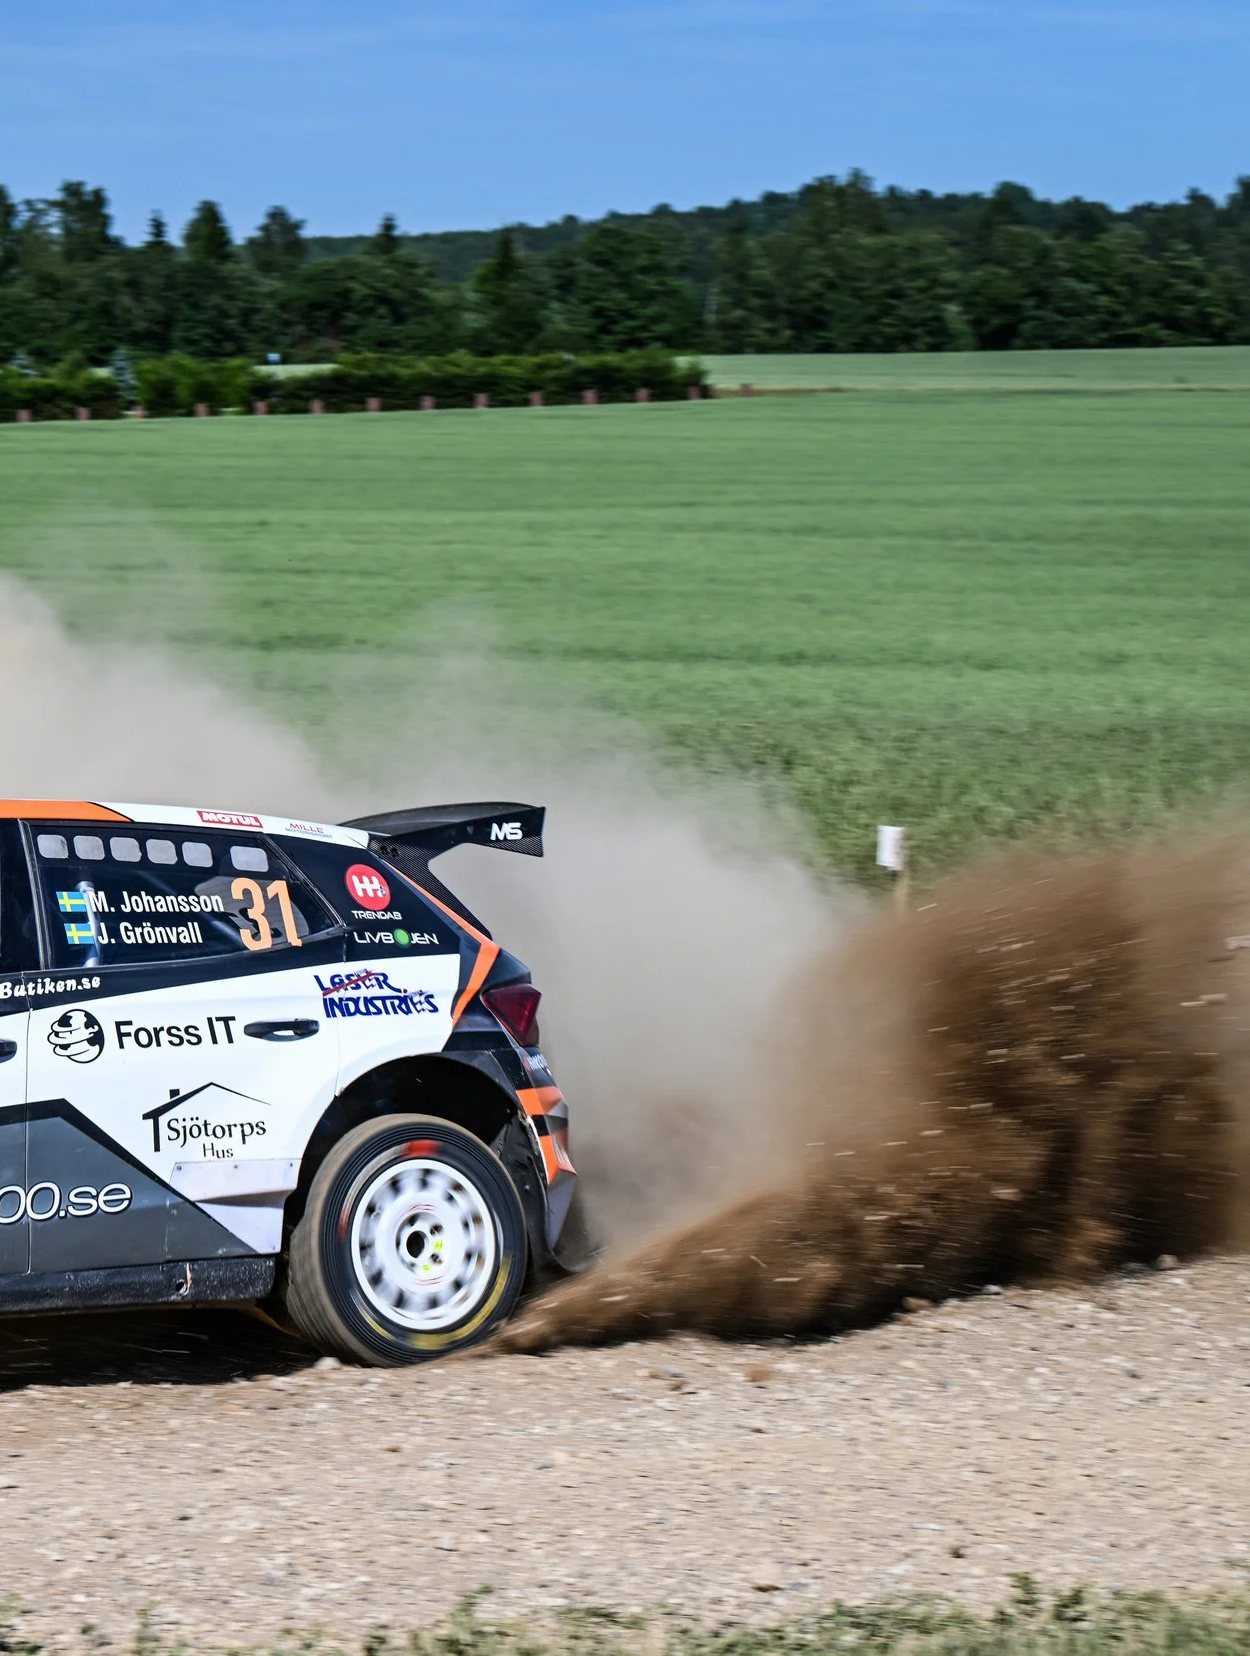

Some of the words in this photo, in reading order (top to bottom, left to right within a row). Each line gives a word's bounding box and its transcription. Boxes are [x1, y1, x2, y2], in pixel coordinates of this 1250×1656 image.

[202, 811, 261, 827] MOTUL
[289, 822, 325, 834] MILLE
[490, 822, 523, 841] MS
[89, 890, 115, 913] M.
[120, 890, 225, 914] Johansson
[230, 877, 303, 951] 31
[351, 910, 403, 921] TRENDAB
[97, 922, 116, 945] J.
[119, 921, 203, 945] Grönvall
[322, 991, 440, 1018] INDUSTRIES
[114, 1017, 202, 1050] Forss
[206, 1015, 237, 1045] IT
[166, 1116, 268, 1149] Sjötorps
[202, 1142, 235, 1159] Hus
